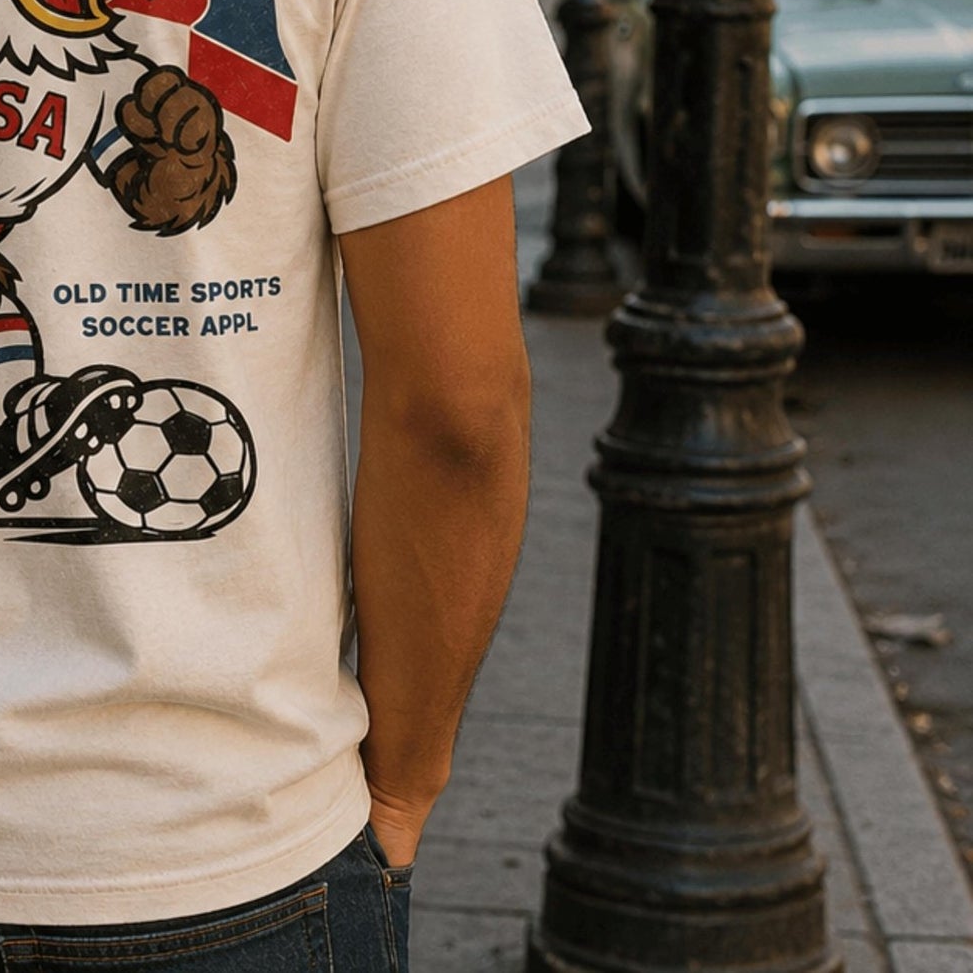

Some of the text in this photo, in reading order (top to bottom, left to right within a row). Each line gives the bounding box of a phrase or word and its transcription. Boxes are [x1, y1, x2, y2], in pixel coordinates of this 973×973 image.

[53, 276, 281, 305] OLD TIME SPORTS
[82, 312, 258, 337] SOCCER APPL
